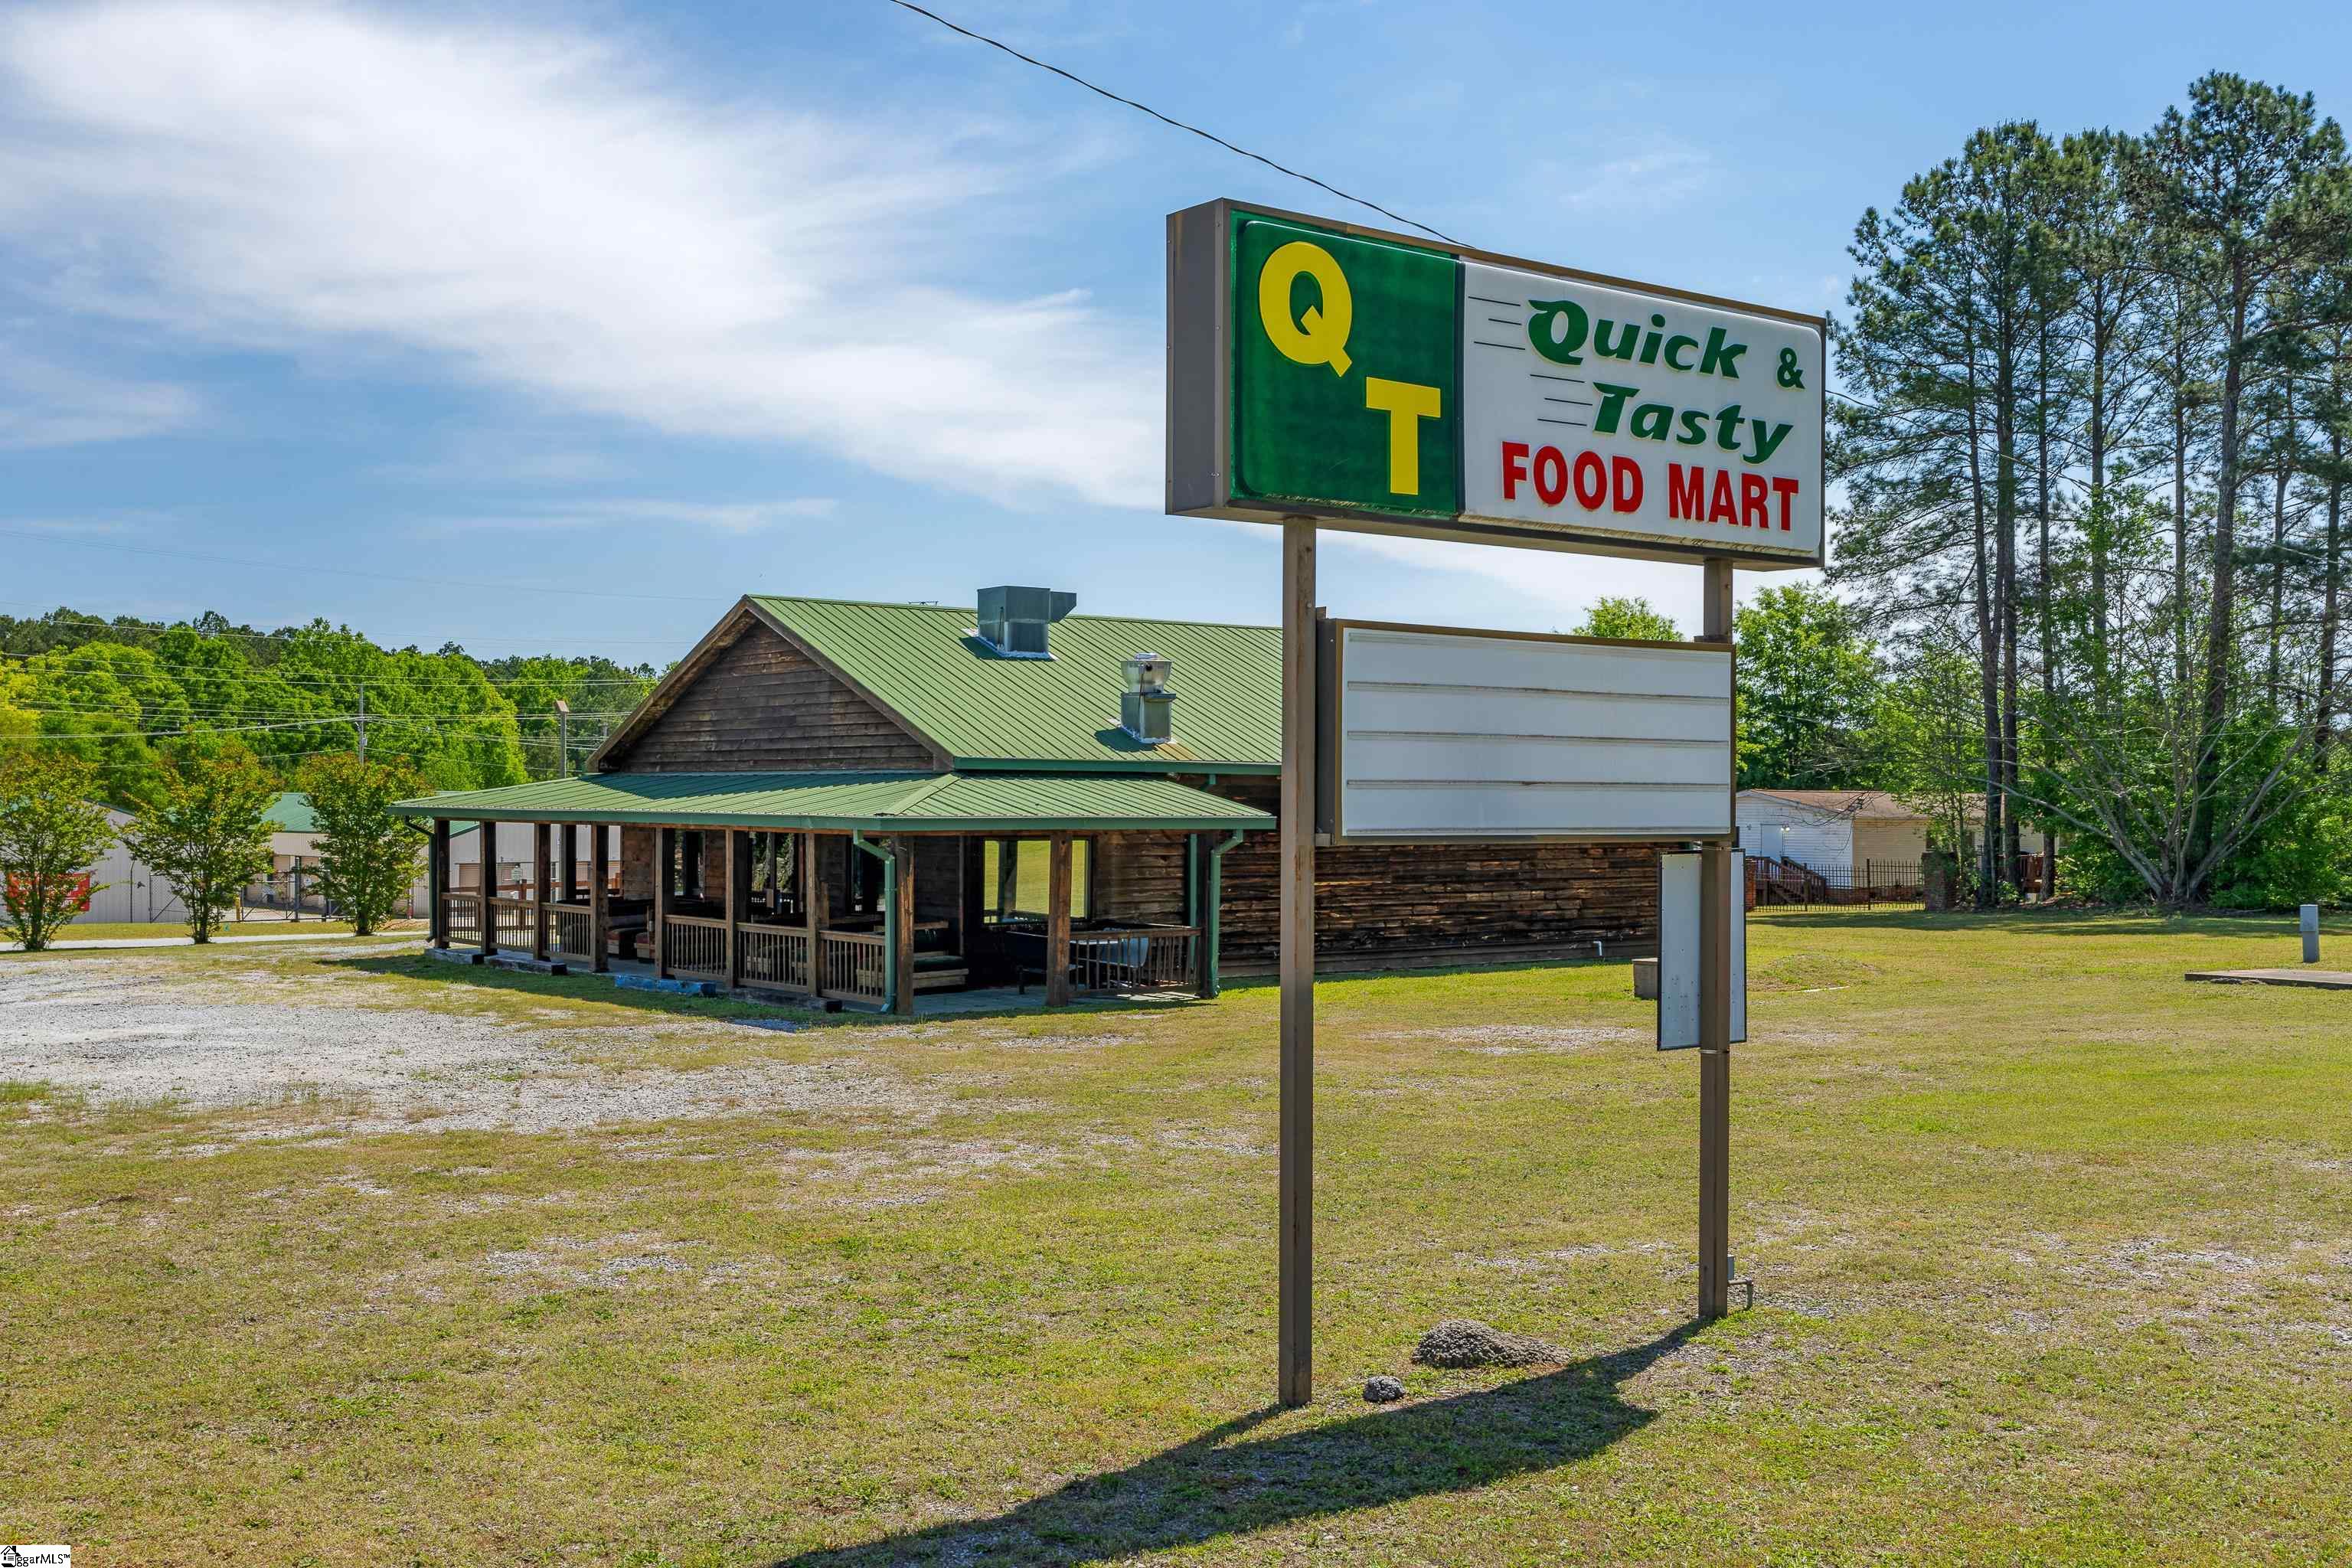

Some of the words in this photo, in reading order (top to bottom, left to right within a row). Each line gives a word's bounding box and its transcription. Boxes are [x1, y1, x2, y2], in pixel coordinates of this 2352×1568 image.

[1259, 241, 1353, 377] Q
[1526, 296, 1748, 380] Quick
[1775, 347, 1806, 392] &
[1365, 376, 1442, 496] T
[1591, 381, 1794, 465] Tasty
[1501, 440, 1645, 514] FOOD
[1668, 462, 1800, 532] MART
